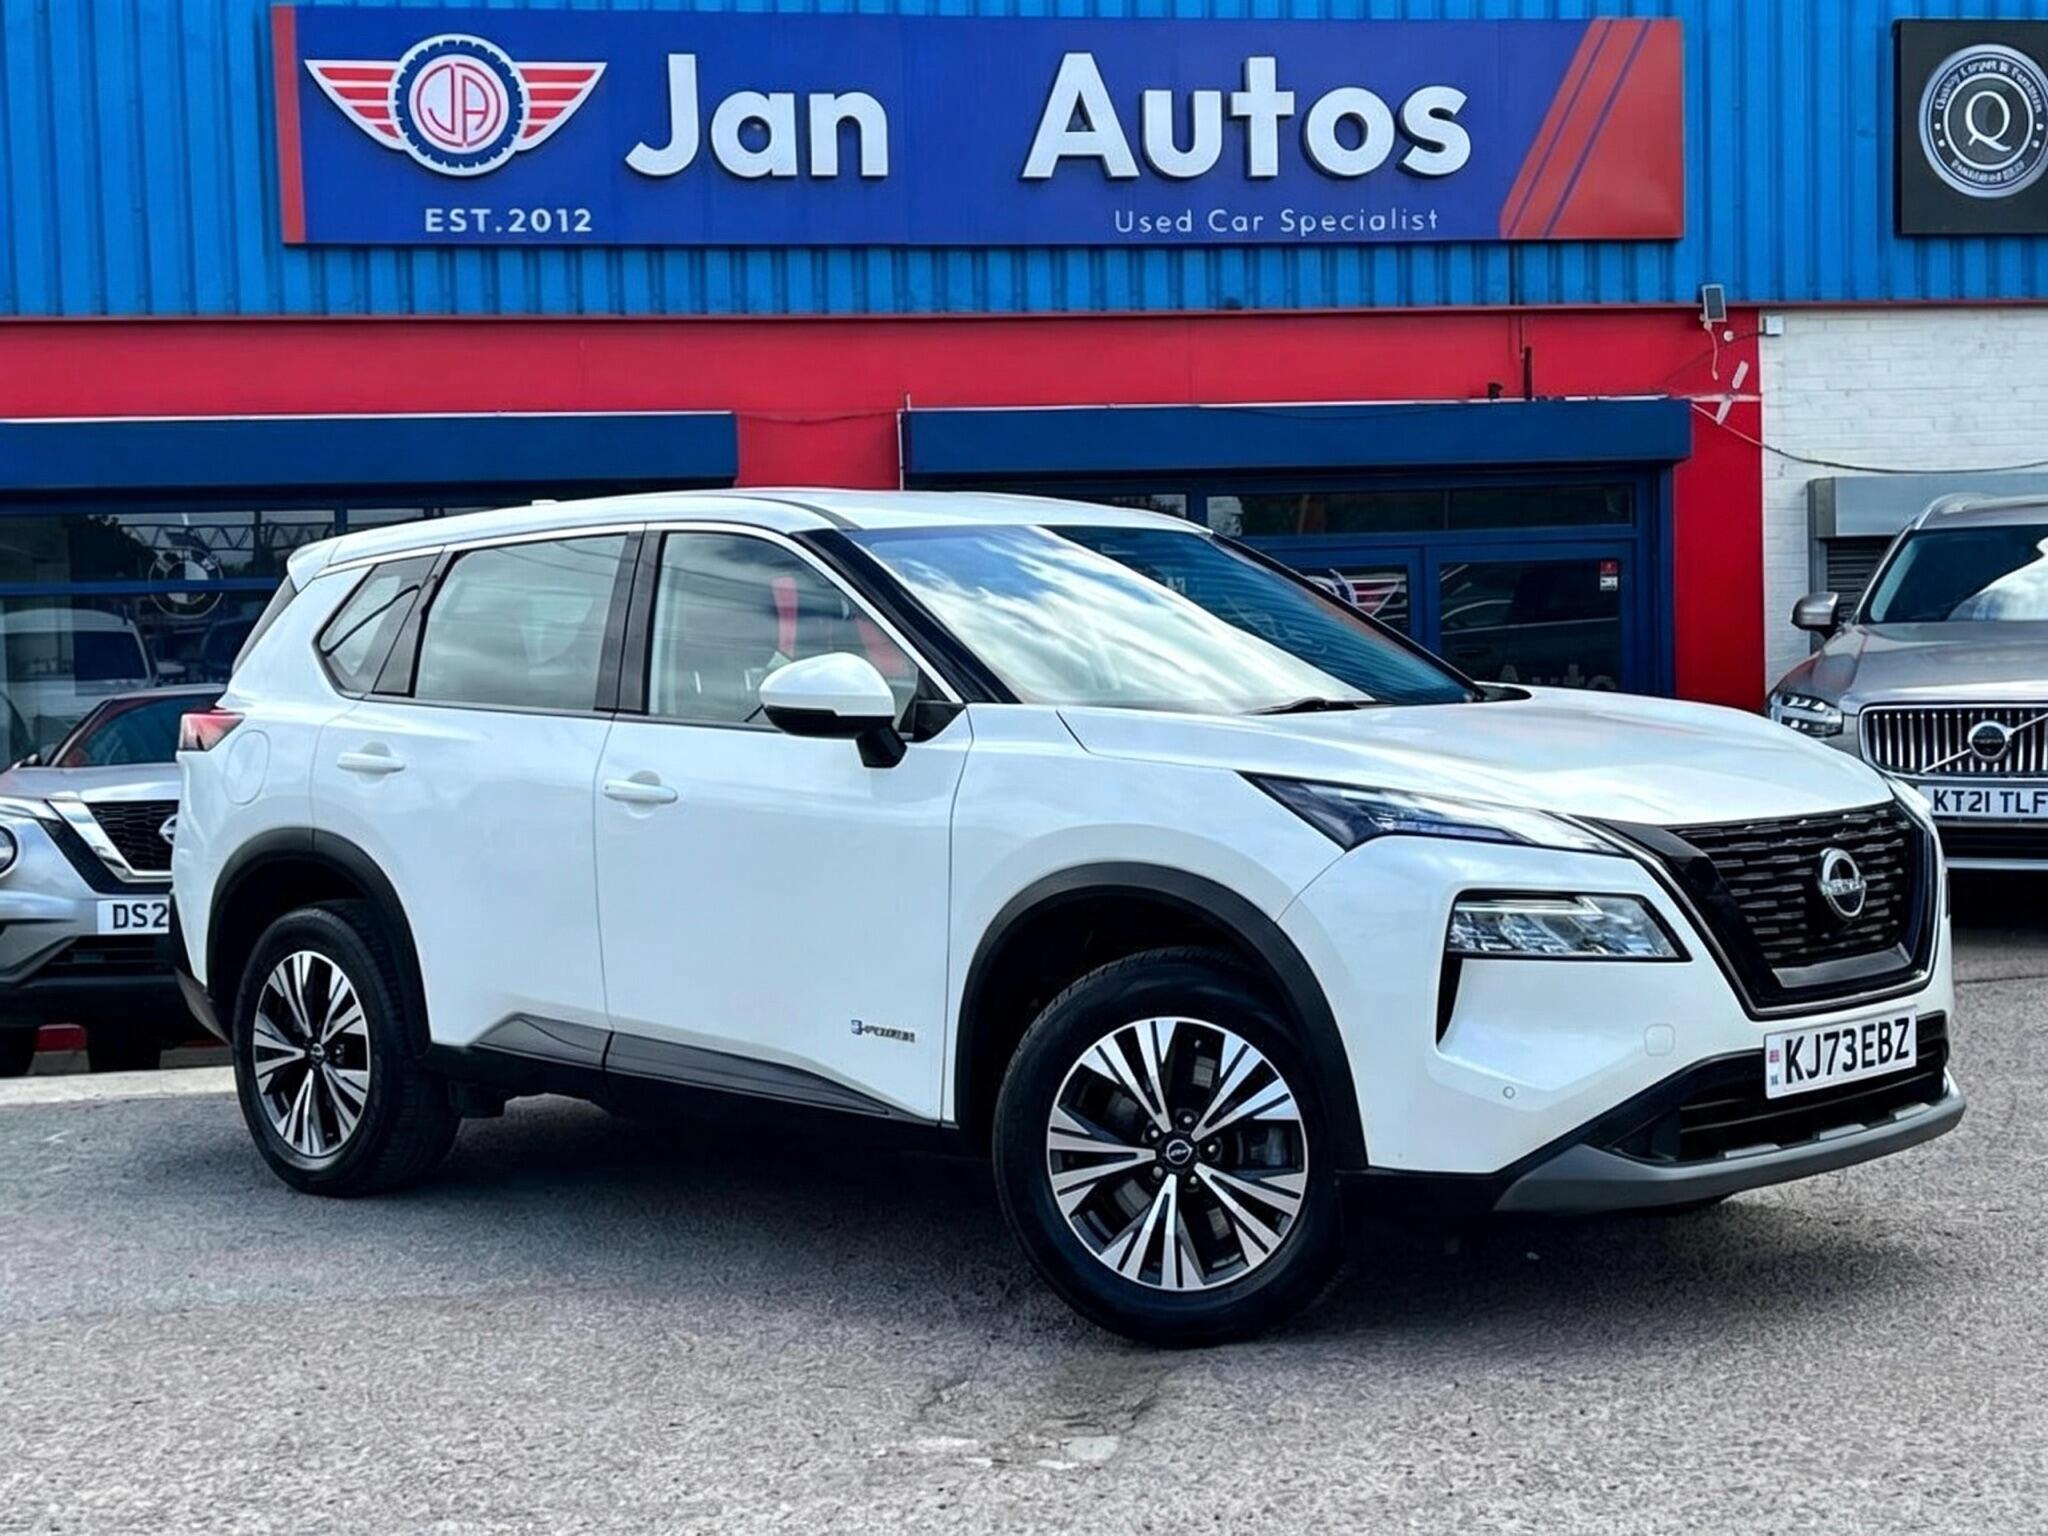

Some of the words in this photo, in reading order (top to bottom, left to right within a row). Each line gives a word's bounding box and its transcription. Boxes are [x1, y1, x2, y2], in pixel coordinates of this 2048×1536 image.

[625, 53, 888, 177] Jan
[1022, 52, 1471, 178] Autos
[1965, 90, 2013, 152] Q
[425, 208, 592, 233] EST.2012
[1115, 208, 1193, 233] Used
[1207, 208, 1264, 233] Car
[1279, 207, 1439, 236] Specialist
[1933, 789, 1990, 812] KT21
[1999, 790, 2048, 814] TLF
[112, 902, 168, 930] DS2
[1785, 1016, 1910, 1084] KJ73EBZ
